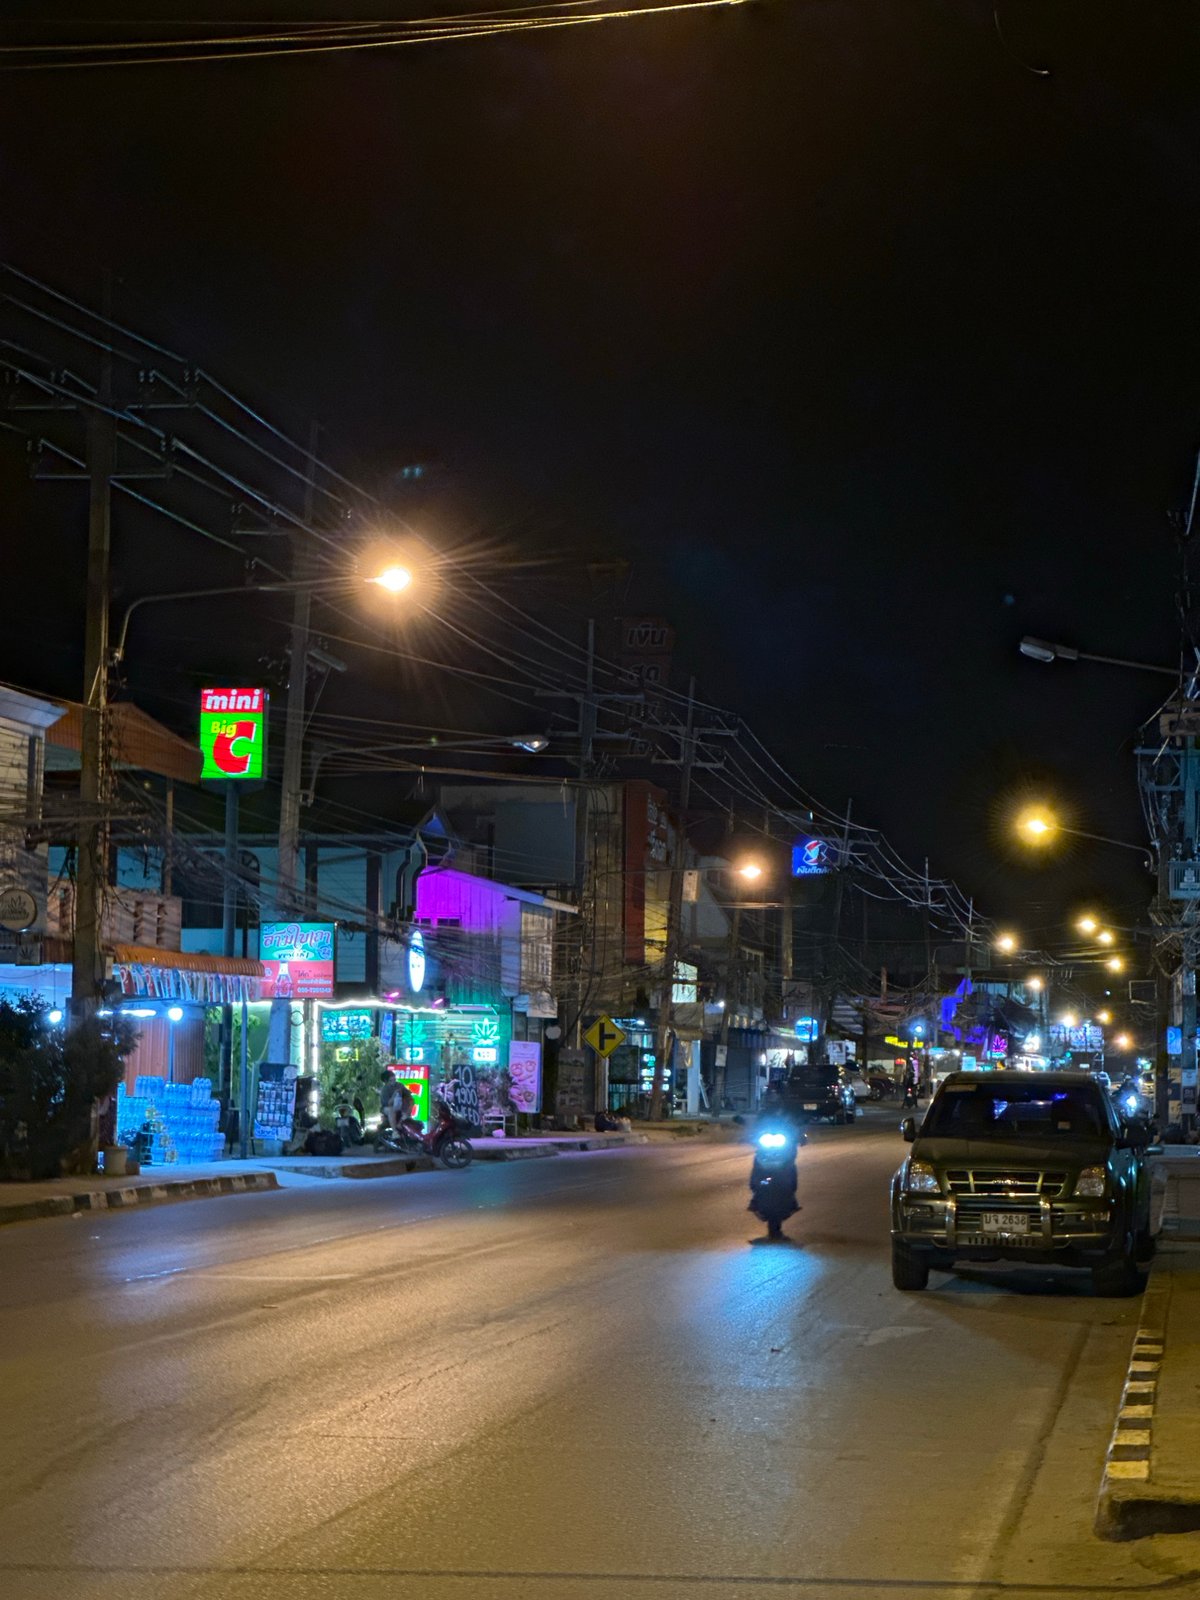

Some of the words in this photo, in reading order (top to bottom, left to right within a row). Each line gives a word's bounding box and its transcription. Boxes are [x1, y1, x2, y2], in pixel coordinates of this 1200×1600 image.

[206, 689, 260, 709] mini
[211, 720, 237, 738] Big
[213, 720, 257, 775] C
